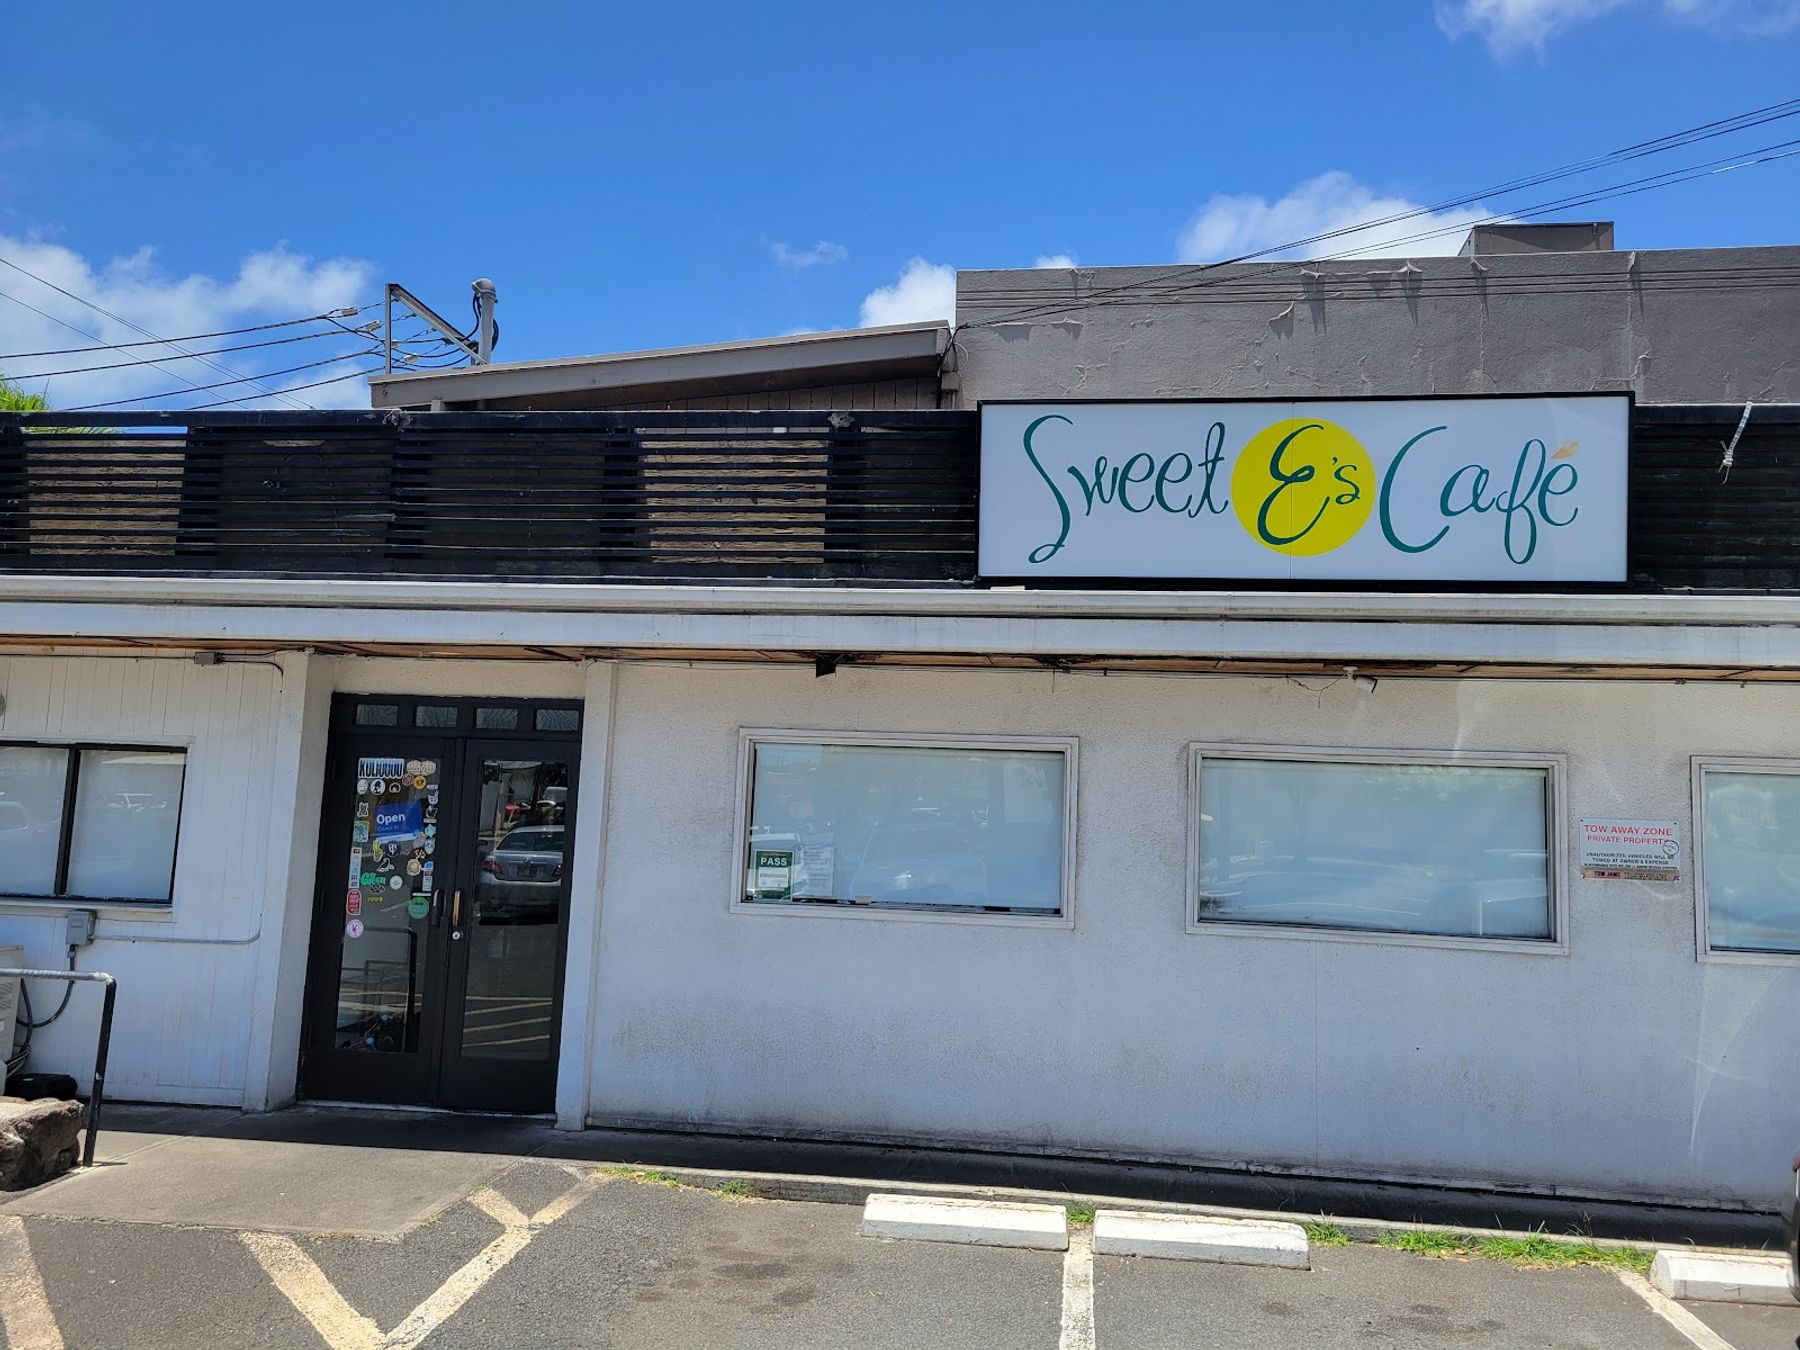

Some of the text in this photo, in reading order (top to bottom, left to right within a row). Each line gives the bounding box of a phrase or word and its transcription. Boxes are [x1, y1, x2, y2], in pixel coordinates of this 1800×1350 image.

[1022, 414, 1580, 565] Sweet E's Café
[376, 813, 406, 826] Open
[1584, 824, 1673, 836] TOW AWAY ZONE
[1587, 835, 1621, 843] PRIVATE
[760, 857, 787, 866] PASS
